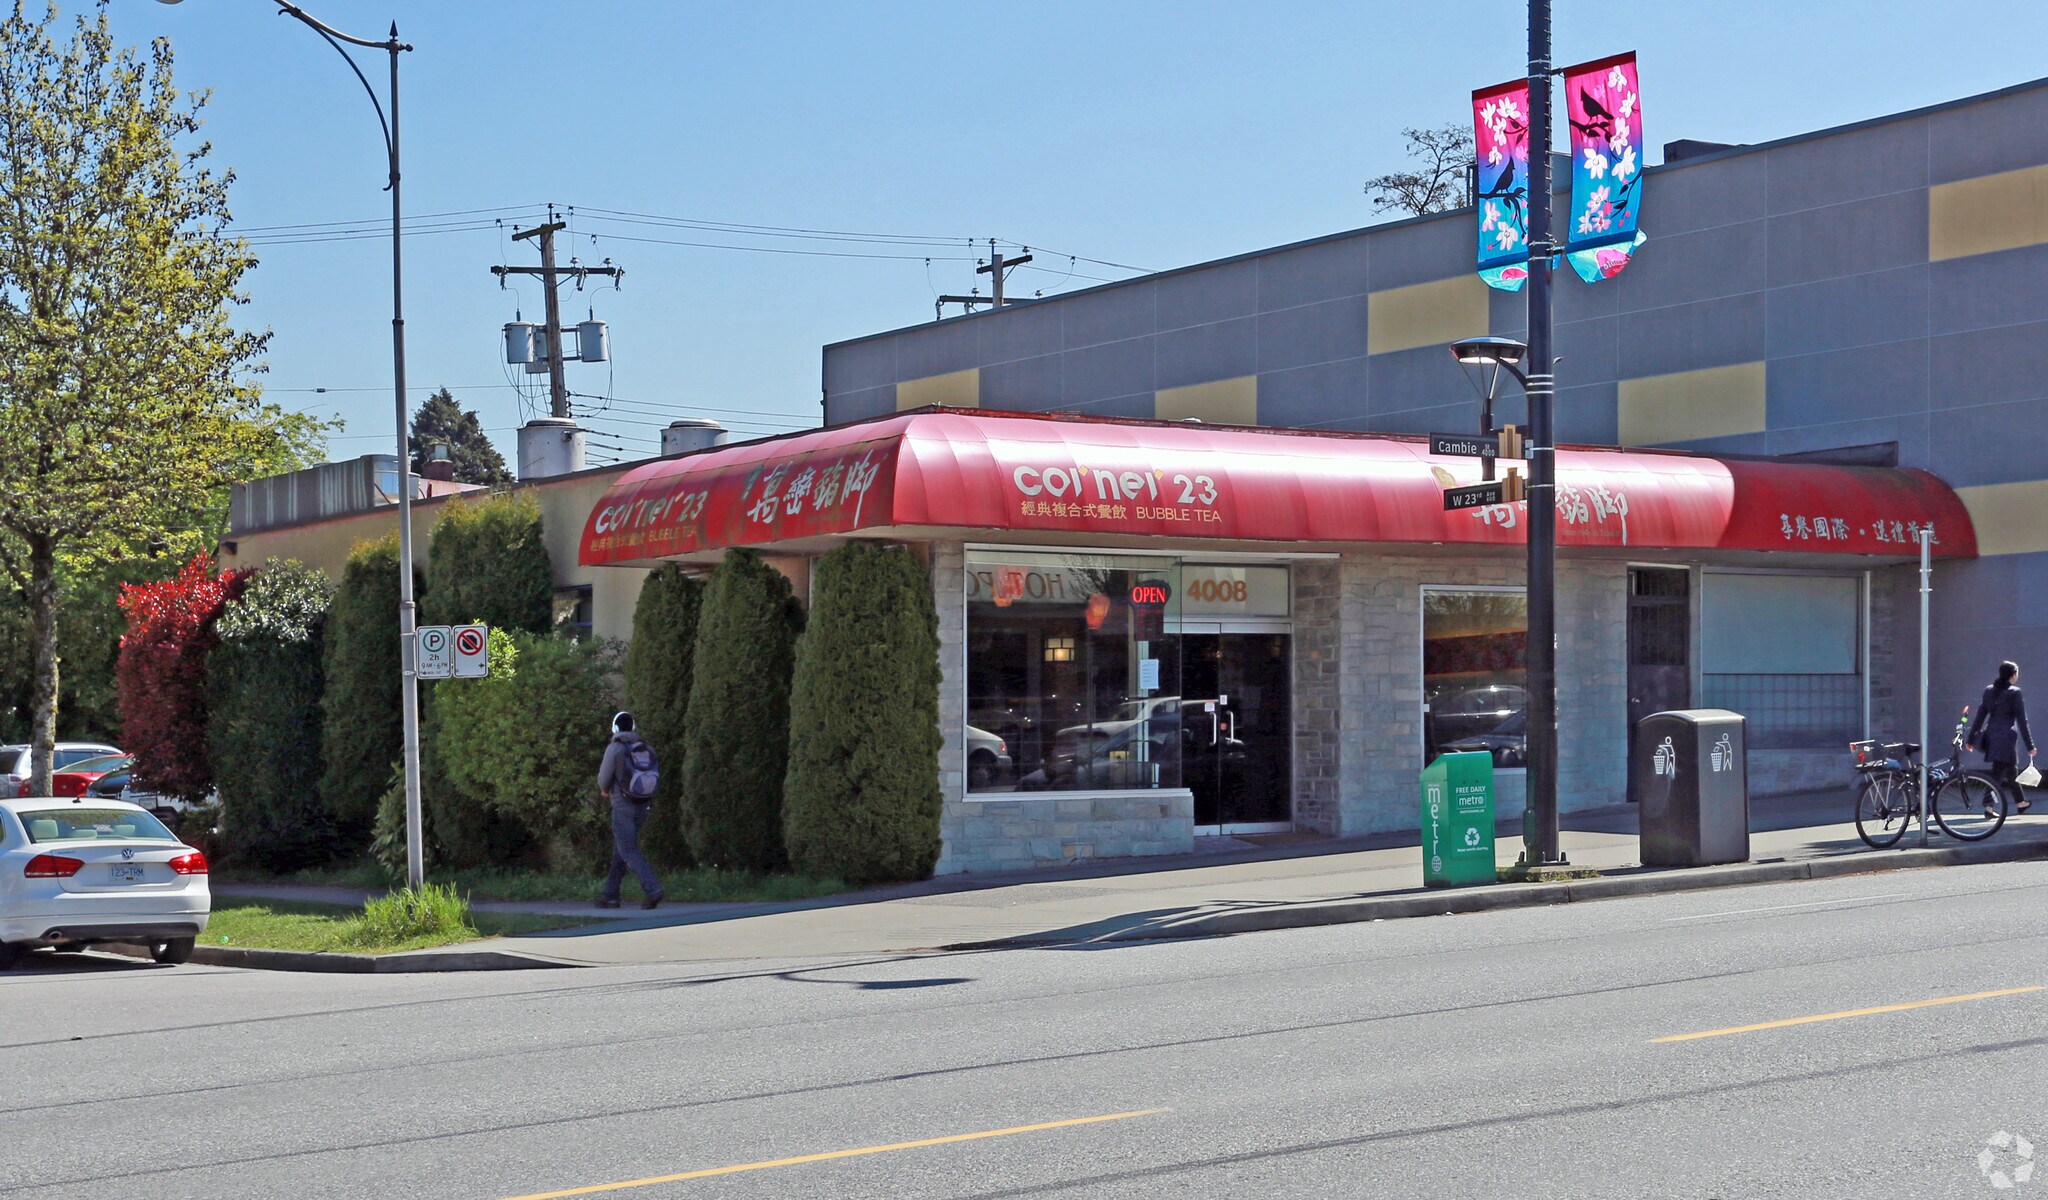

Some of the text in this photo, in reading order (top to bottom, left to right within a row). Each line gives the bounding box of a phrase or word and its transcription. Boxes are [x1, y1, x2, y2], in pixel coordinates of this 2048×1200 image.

[1438, 441, 1477, 454] Cambie
[1013, 465, 1218, 505] corner 23
[677, 491, 708, 522] 23
[1453, 495, 1462, 506] W
[1136, 507, 1222, 523] BUBBLE TEA
[1132, 586, 1167, 604] OPEN
[1187, 579, 1248, 603] 4008
[1455, 785, 1486, 794] FREE DAILY
[1458, 796, 1484, 805] metro
